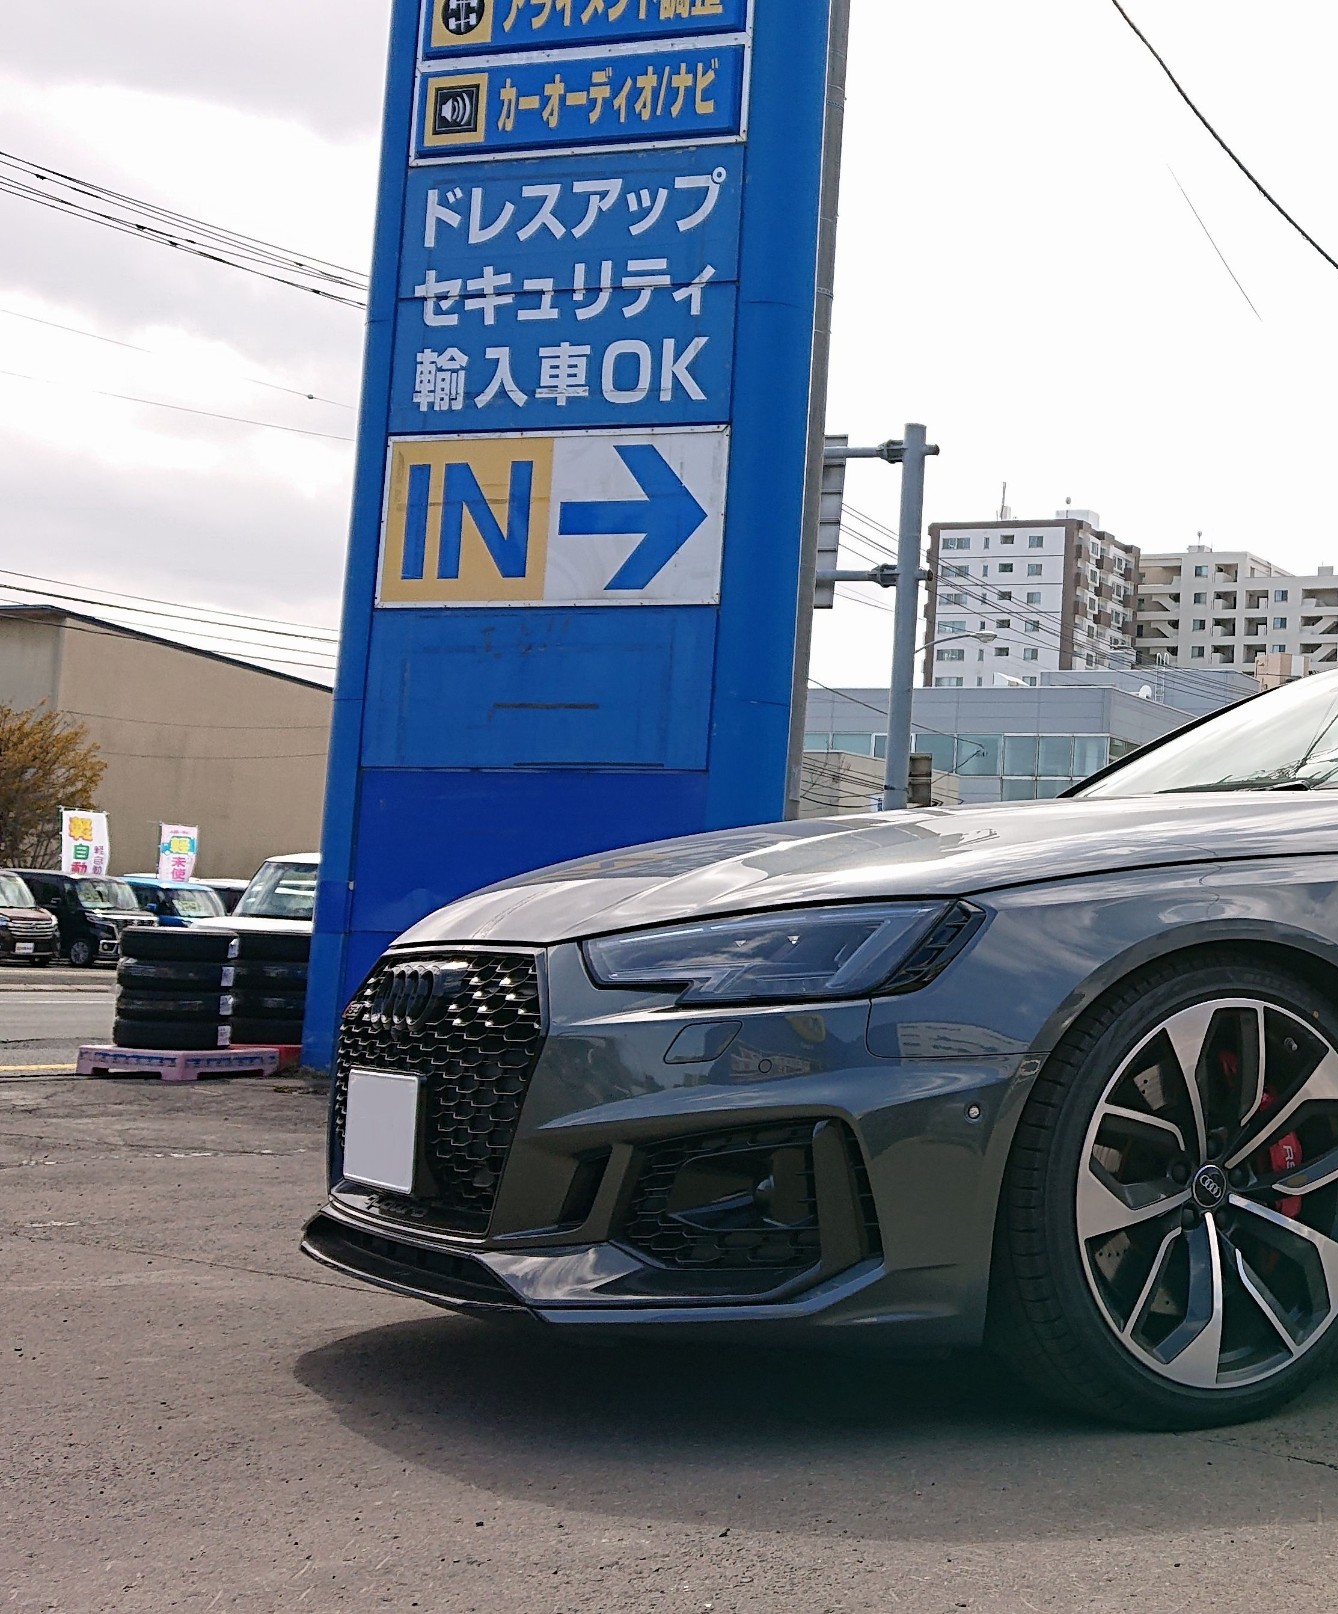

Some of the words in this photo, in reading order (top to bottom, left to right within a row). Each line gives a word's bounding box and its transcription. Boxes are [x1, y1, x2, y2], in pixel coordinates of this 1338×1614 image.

[497, 57, 719, 132] カーオーディオ/ナビ
[424, 166, 727, 248] ドレスアップ
[414, 257, 716, 327] セキュリティ
[412, 336, 710, 411] 輸入車OK
[400, 460, 534, 580] IN
